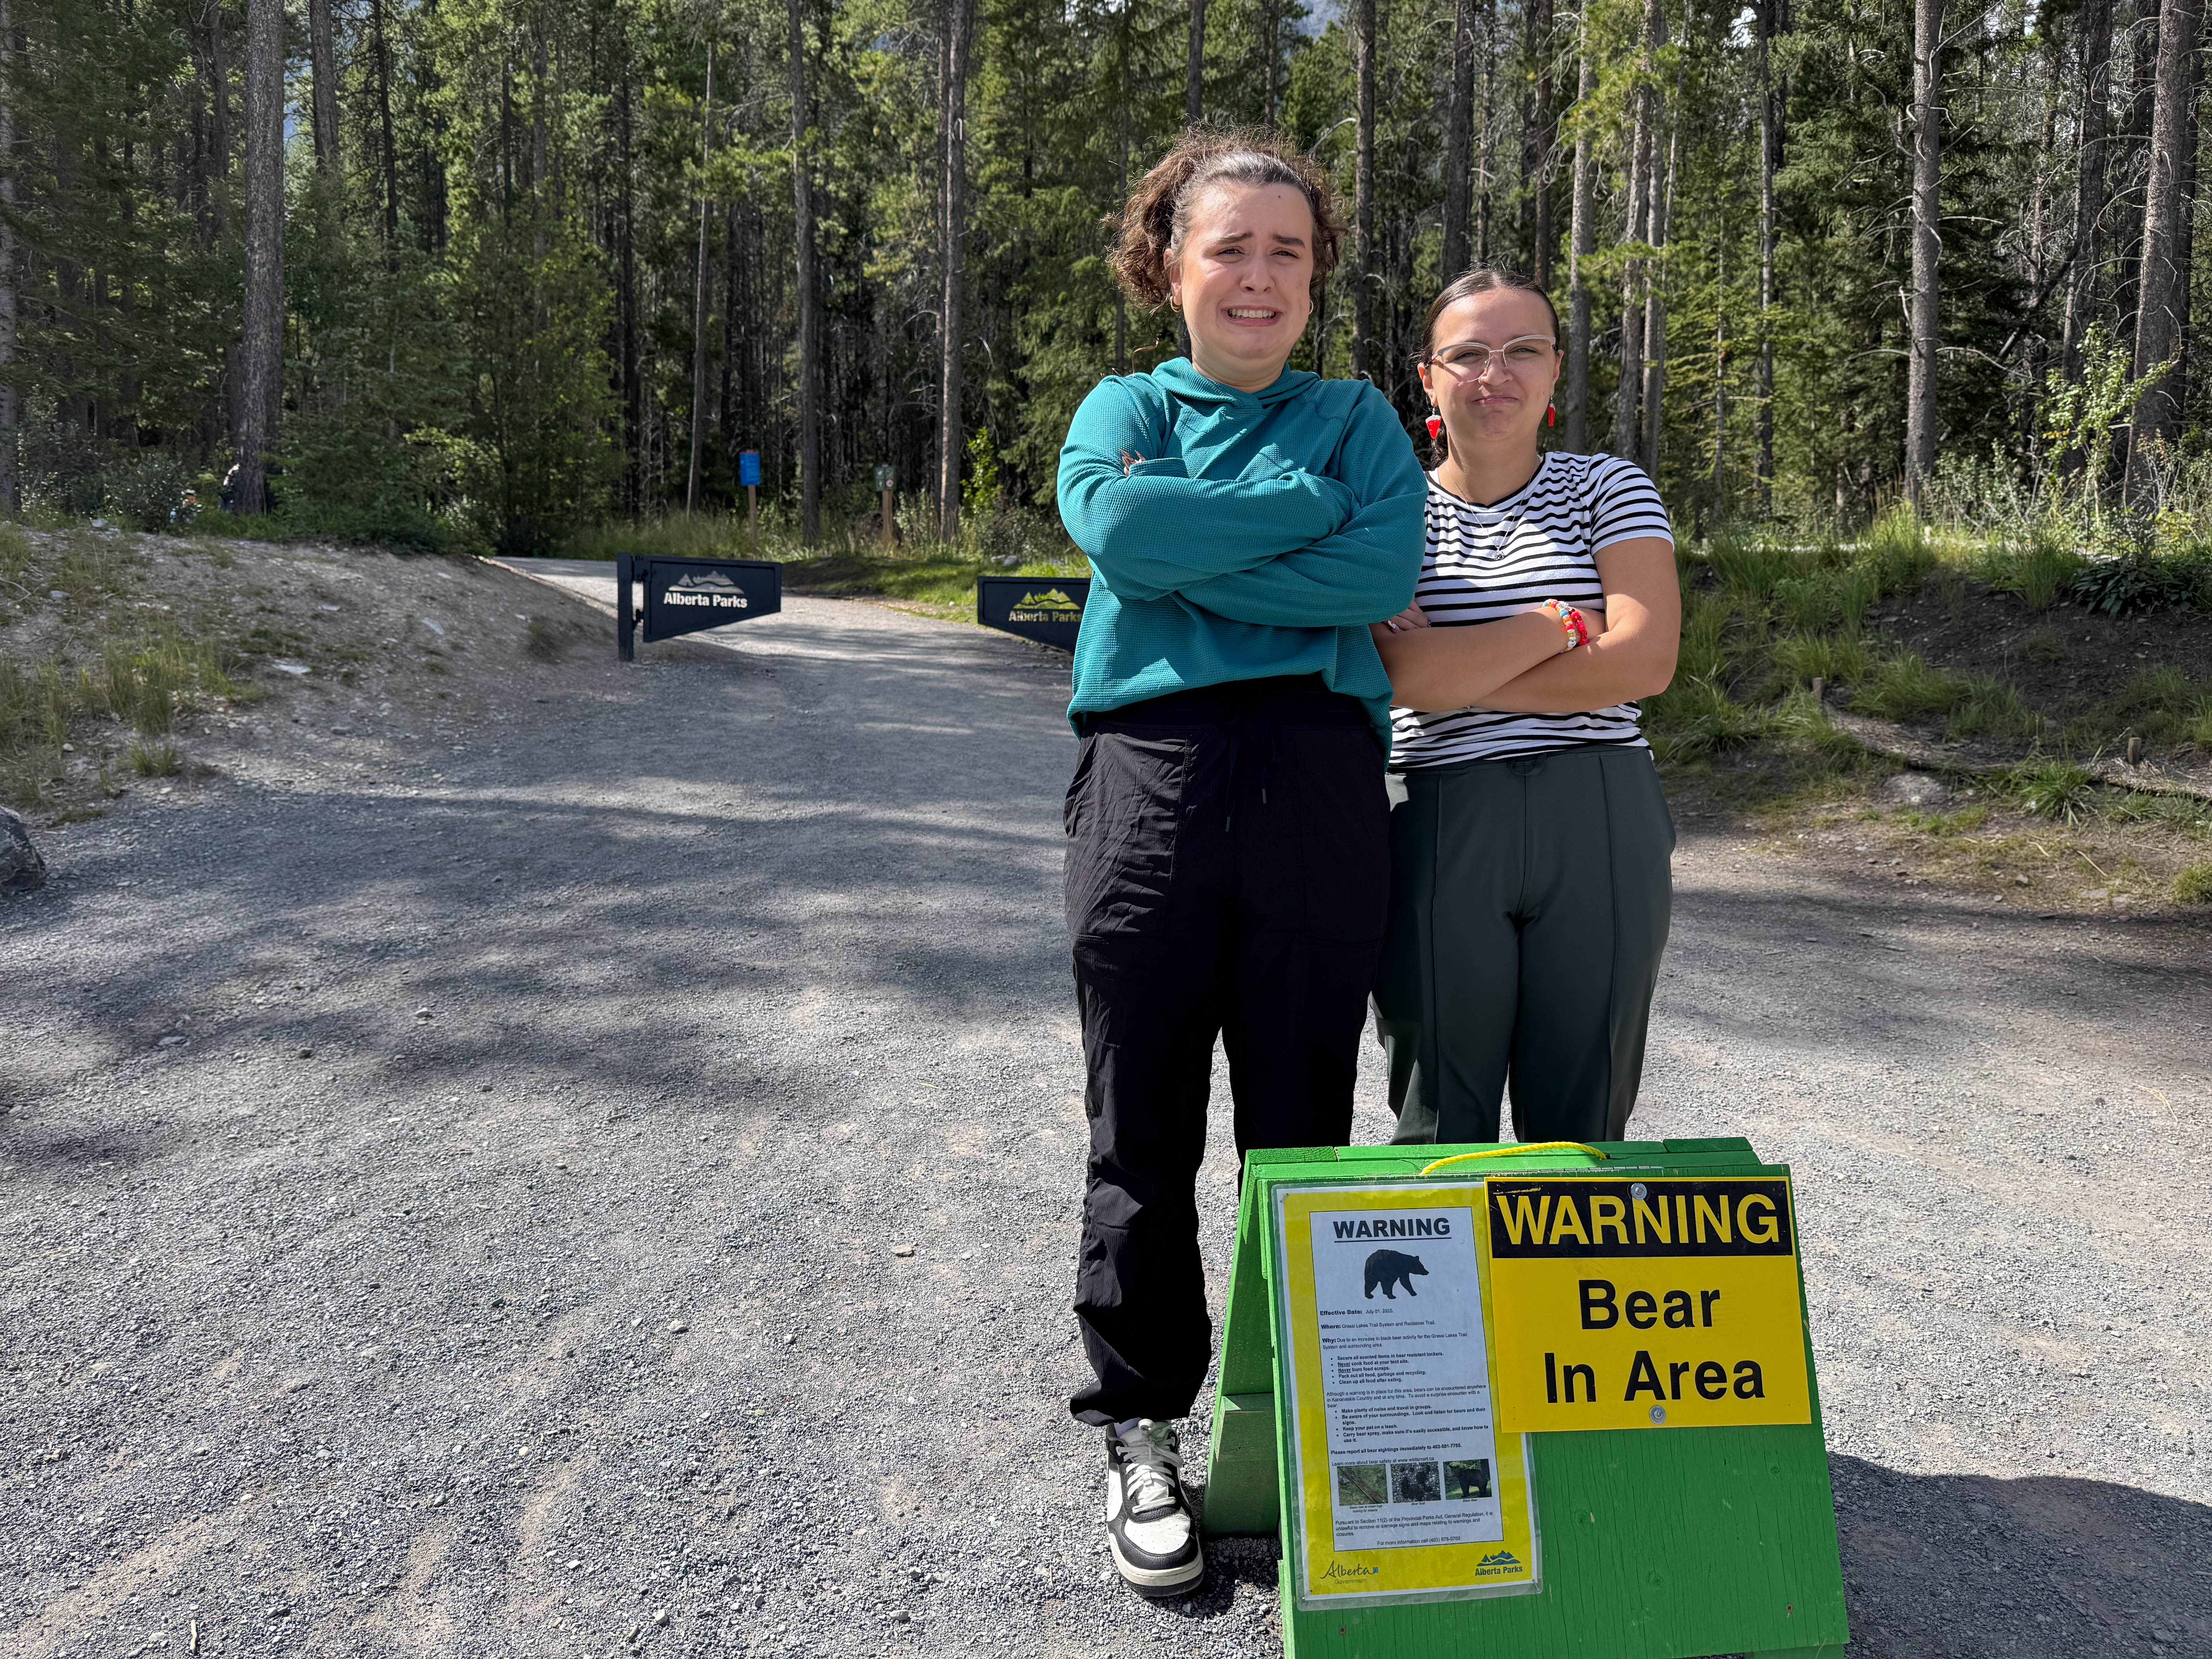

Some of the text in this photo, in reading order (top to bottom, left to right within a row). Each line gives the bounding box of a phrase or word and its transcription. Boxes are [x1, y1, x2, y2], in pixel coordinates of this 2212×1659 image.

[663, 592, 747, 608] Alberta Parks
[1008, 611, 1082, 622] Alberta Parks
[1333, 1217, 1451, 1238] WARNING
[1496, 1194, 1779, 1245] WARNING
[1578, 1279, 1720, 1330] Bear
[1545, 1350, 1766, 1403] In Area
[1320, 1561, 1375, 1579] Alberta
[1475, 1567, 1501, 1576] Alberta
